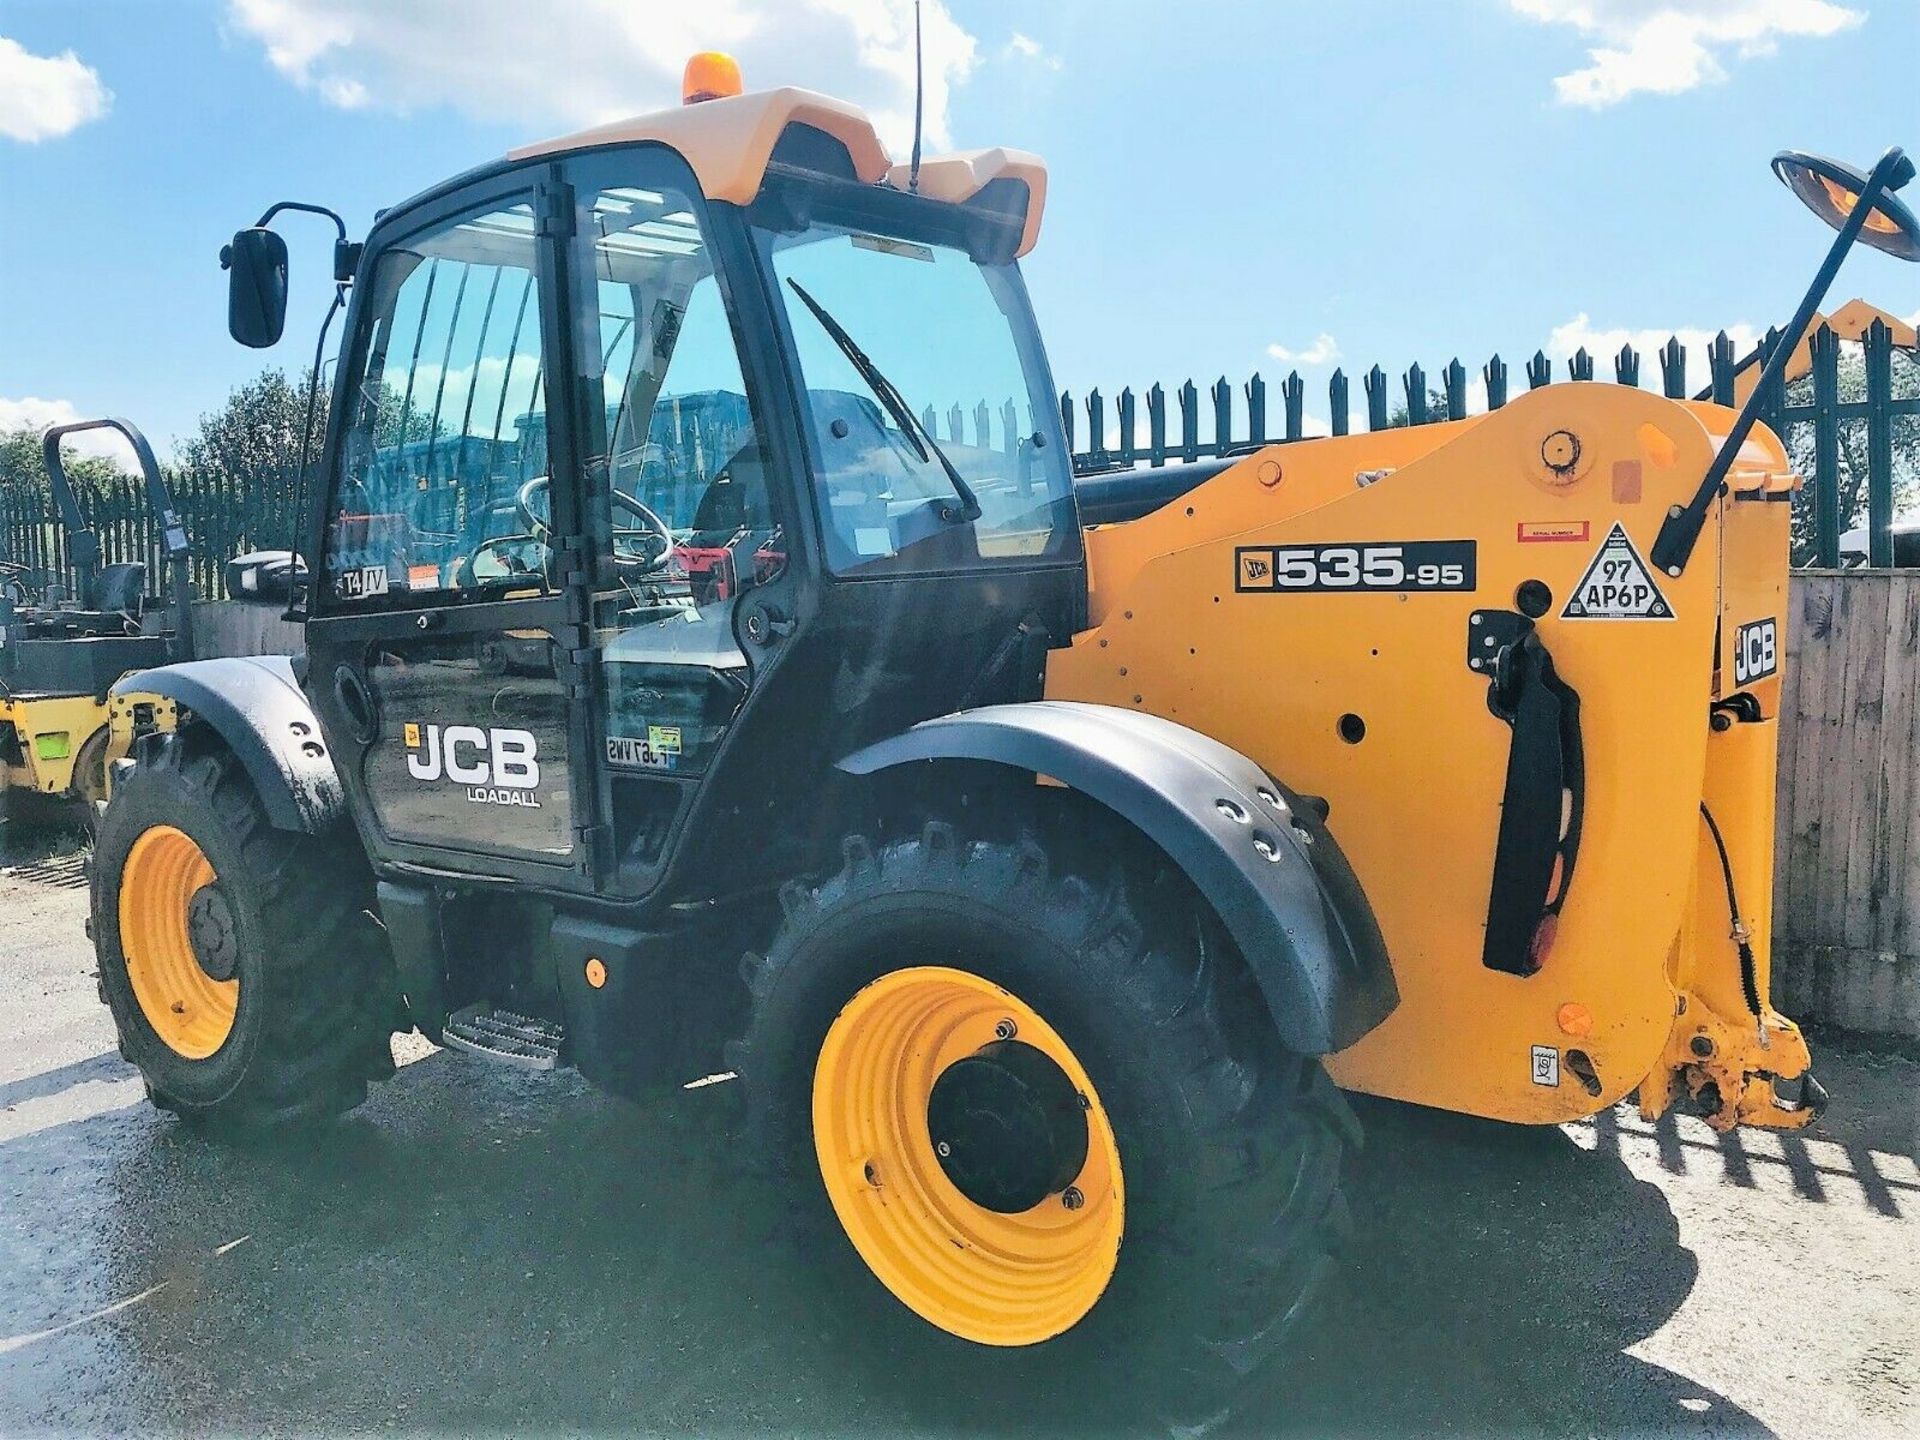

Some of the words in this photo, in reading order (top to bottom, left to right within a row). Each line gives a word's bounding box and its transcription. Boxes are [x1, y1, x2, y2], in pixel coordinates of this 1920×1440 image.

[1247, 558, 1269, 579] JCB
[1277, 547, 1464, 587] 535-95
[1602, 559, 1632, 583] 97
[343, 571, 362, 594] T4
[365, 570, 384, 592] IV
[1586, 584, 1649, 608] AP6P
[1736, 623, 1776, 682] JCB
[407, 724, 540, 789] JCB
[466, 787, 541, 808] LOADALL
